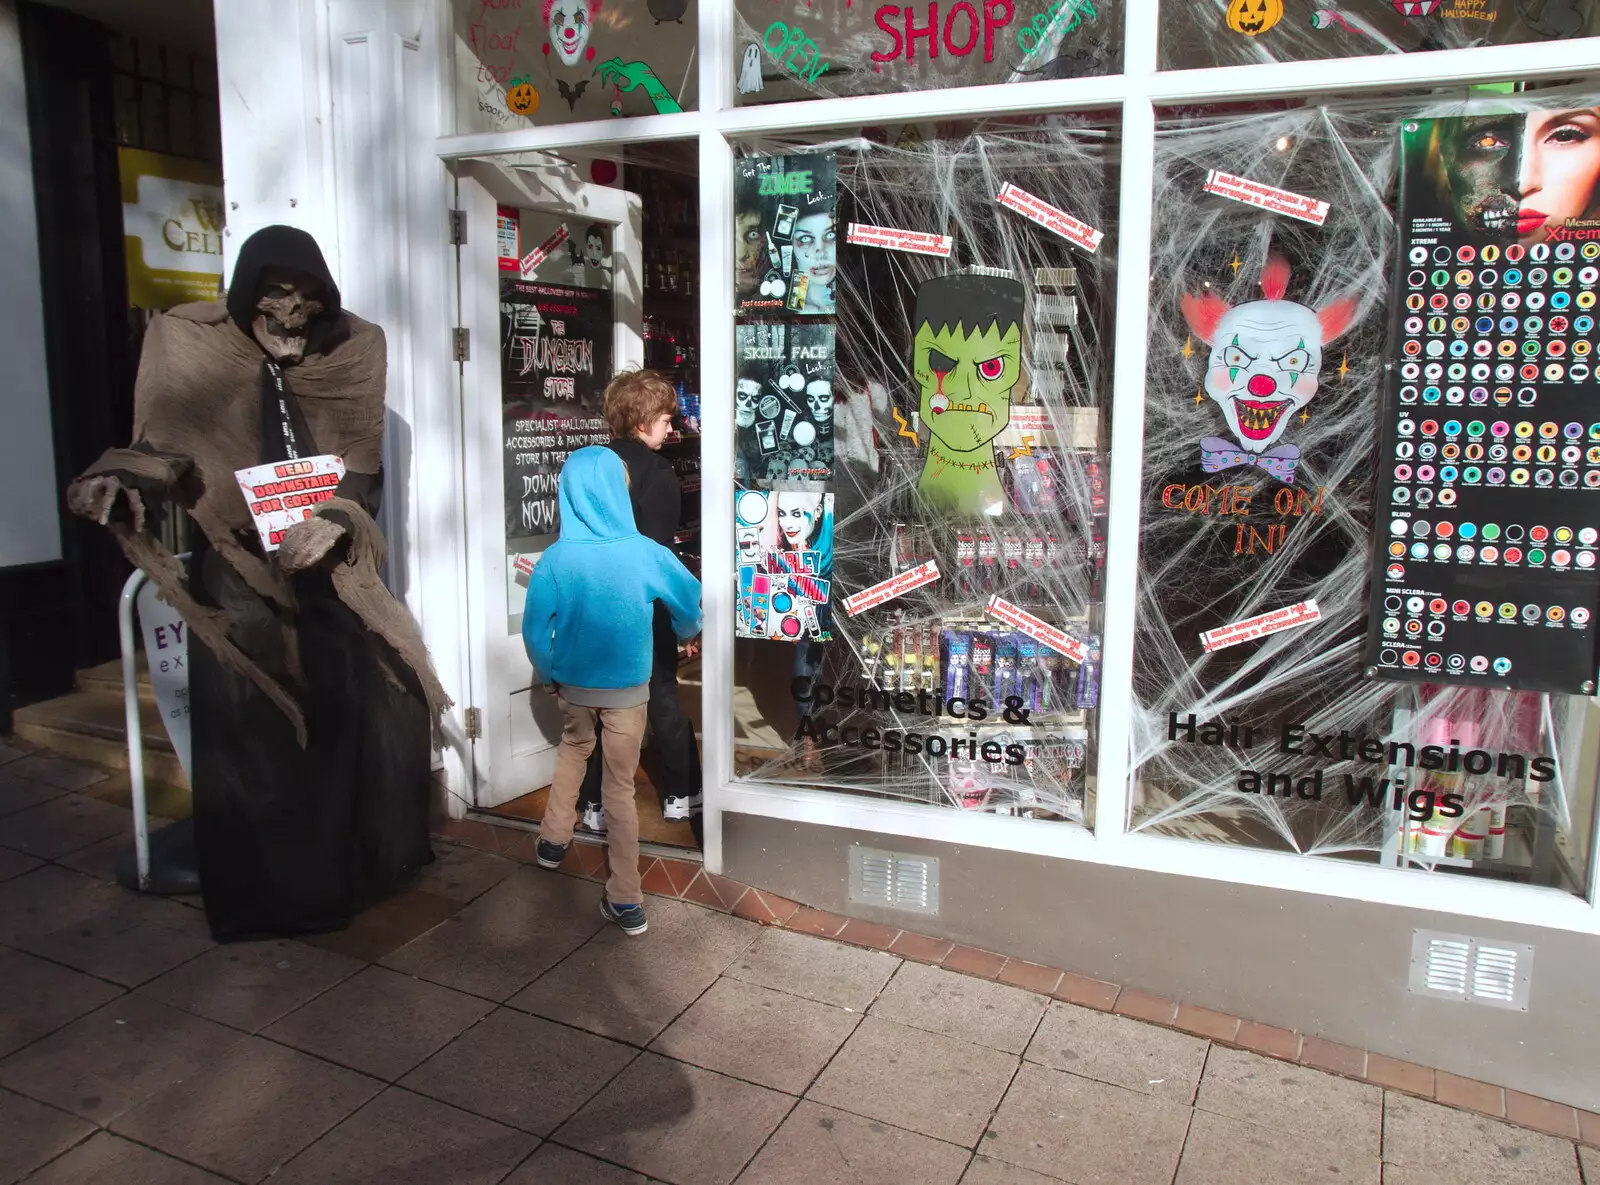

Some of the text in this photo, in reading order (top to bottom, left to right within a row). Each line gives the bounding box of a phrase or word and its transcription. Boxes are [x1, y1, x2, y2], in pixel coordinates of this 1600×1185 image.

[470, 23, 520, 56] Float
[870, 0, 1015, 67] SHOP
[1016, 0, 1098, 57] OPEN
[763, 21, 829, 85] OPEN
[756, 162, 772, 172] The
[1410, 237, 1438, 245] XTREME
[520, 336, 594, 376] DUNGEON
[791, 346, 828, 359] FACE
[515, 419, 559, 432] SPECIALIST
[505, 435, 556, 451] ACCESSORIES
[590, 433, 611, 445] DRESS
[515, 451, 566, 465] STORE IN THE
[252, 472, 339, 499] DOWNSTAIRS
[1161, 483, 1327, 516] COME ON
[251, 498, 283, 516] FOR
[283, 489, 336, 509] COSTUM
[521, 499, 556, 529] NOW
[1234, 523, 1288, 555] IN!
[767, 551, 822, 574] HARLEY
[787, 574, 831, 604] QUINN
[790, 675, 1032, 726] Cosmetics &
[794, 715, 1027, 766] Accessories
[1167, 711, 1556, 782] Hair Extensions
[1237, 768, 1464, 821] and Wigs
